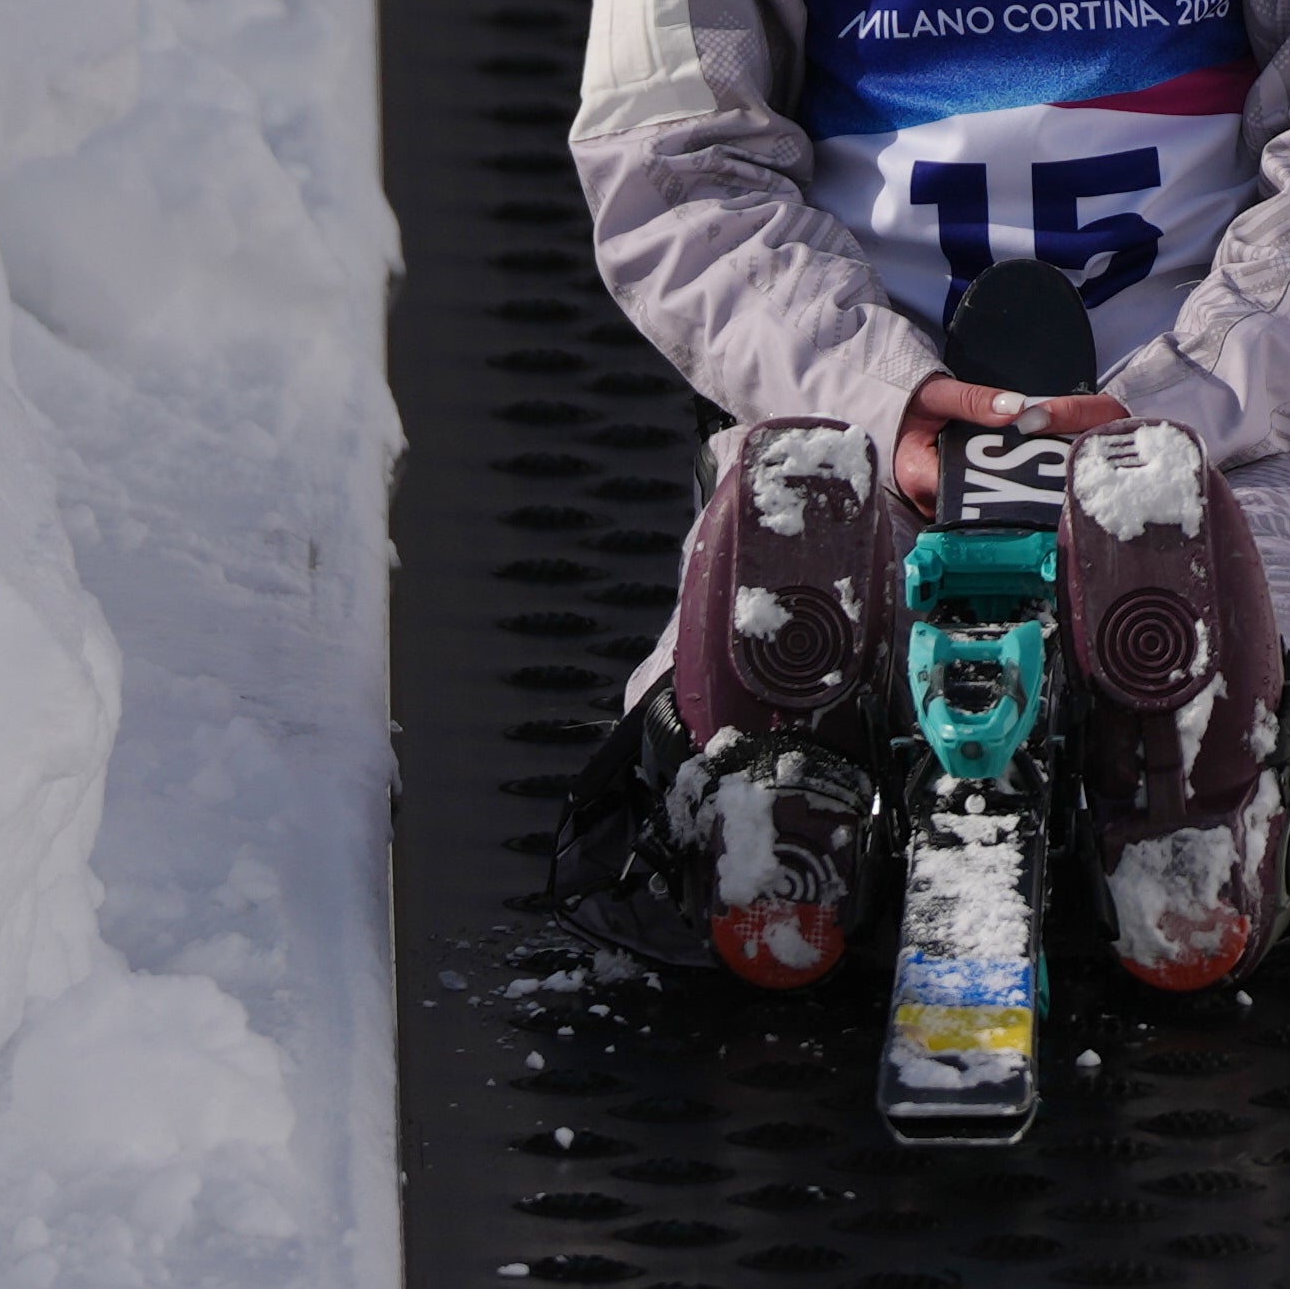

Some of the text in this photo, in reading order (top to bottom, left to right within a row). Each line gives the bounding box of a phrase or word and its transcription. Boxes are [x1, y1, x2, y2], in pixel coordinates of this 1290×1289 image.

[838, 6, 995, 40] MILANO
[910, 146, 1164, 331] 15
[961, 433, 1070, 520] YS
